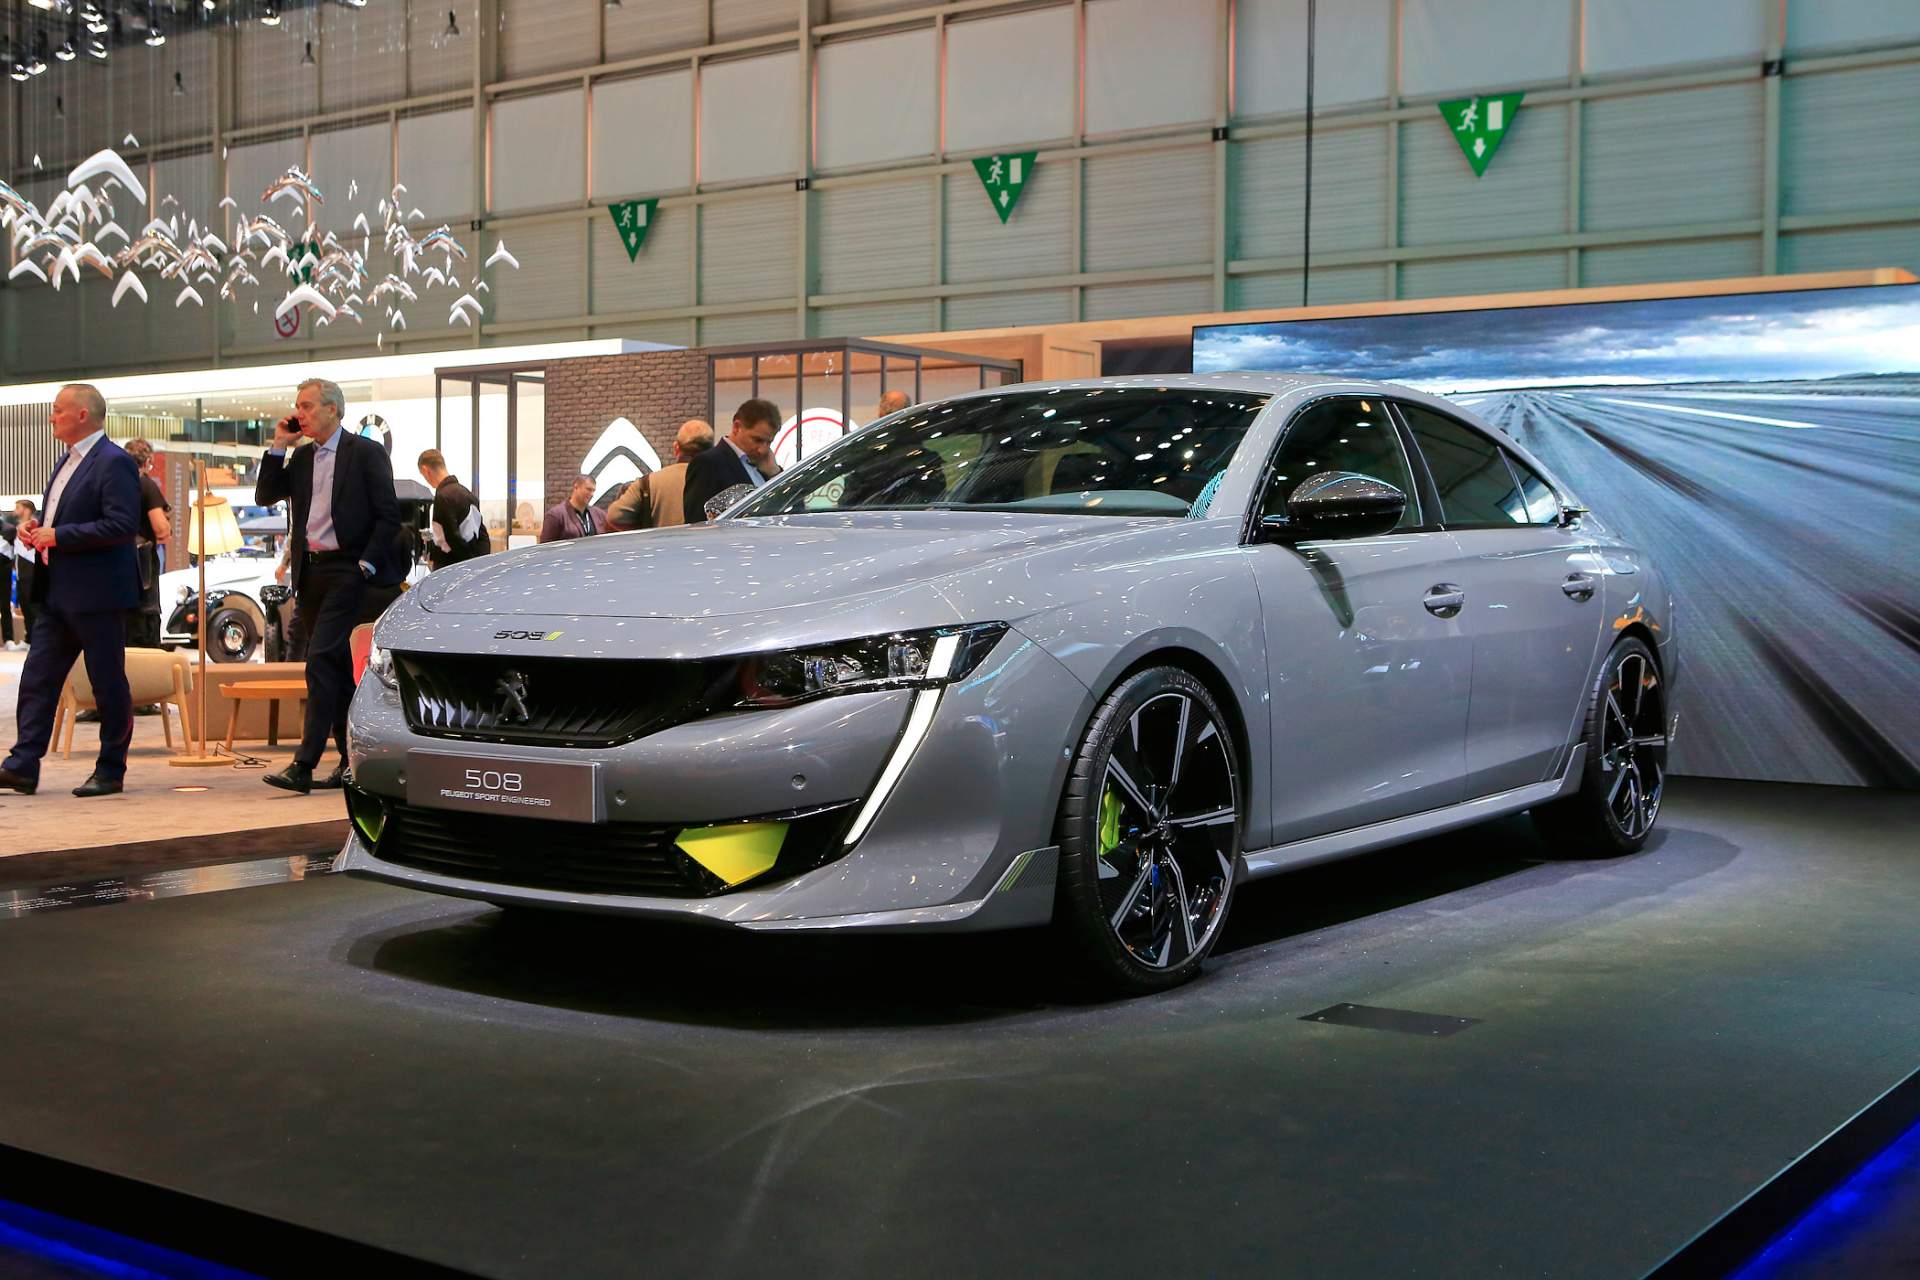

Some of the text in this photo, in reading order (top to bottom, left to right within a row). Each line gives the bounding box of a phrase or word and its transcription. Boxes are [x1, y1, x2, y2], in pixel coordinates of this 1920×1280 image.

[494, 631, 545, 640] 508
[465, 769, 522, 791] 508
[440, 789, 551, 806] PEUGEOT SPORT ENGINEERED
